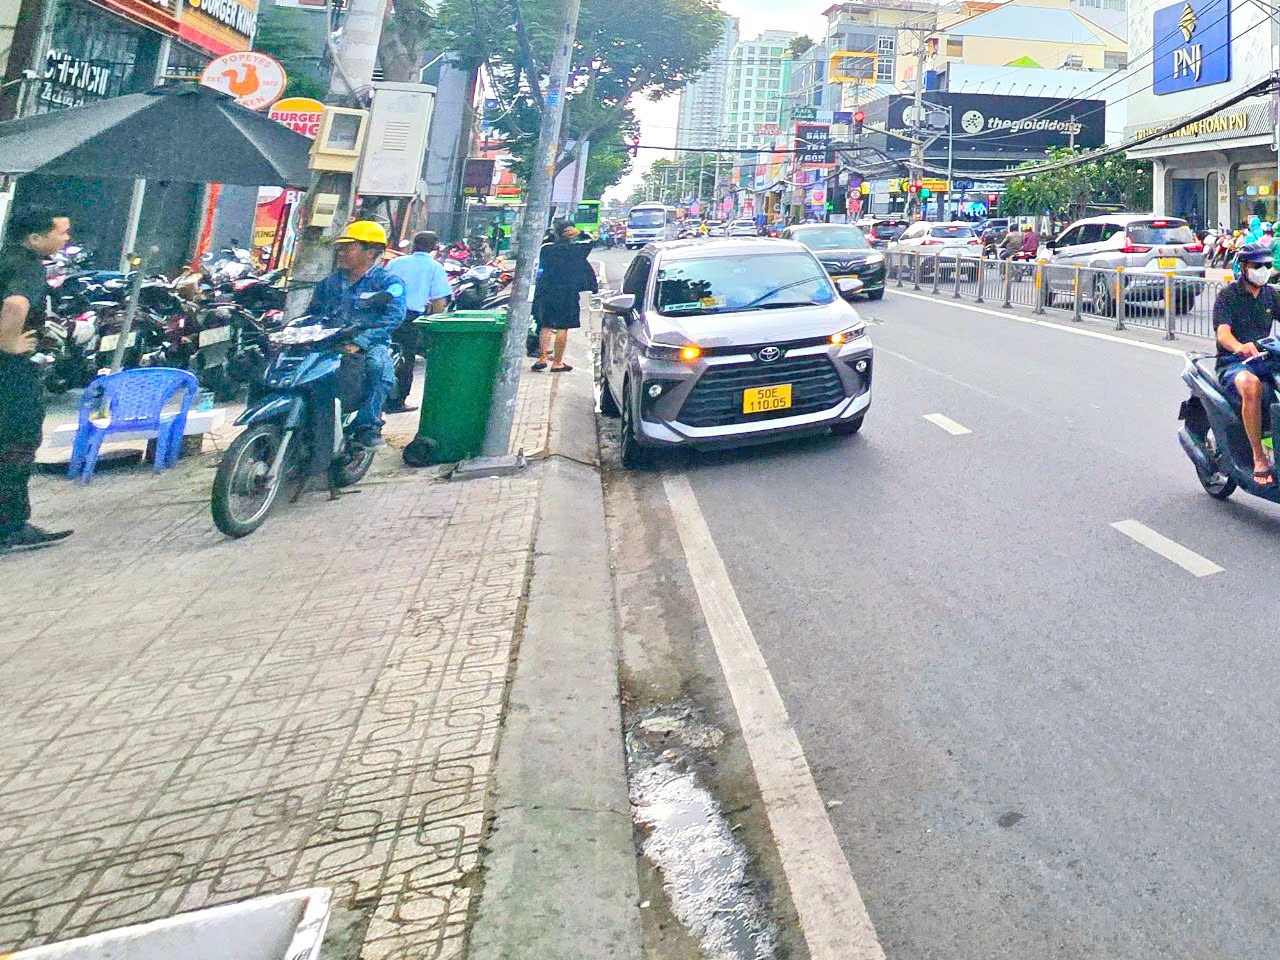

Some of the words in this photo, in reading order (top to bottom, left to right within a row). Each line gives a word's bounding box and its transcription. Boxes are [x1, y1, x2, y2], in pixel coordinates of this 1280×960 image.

[235, 3, 257, 38] KING
[222, 54, 273, 68] POPEYES
[1172, 43, 1203, 83] PNJ
[1198, 115, 1227, 134] HOÀN
[1229, 113, 1248, 132] PNJ
[757, 389, 779, 400] 50E
[750, 397, 787, 412] 110.05
